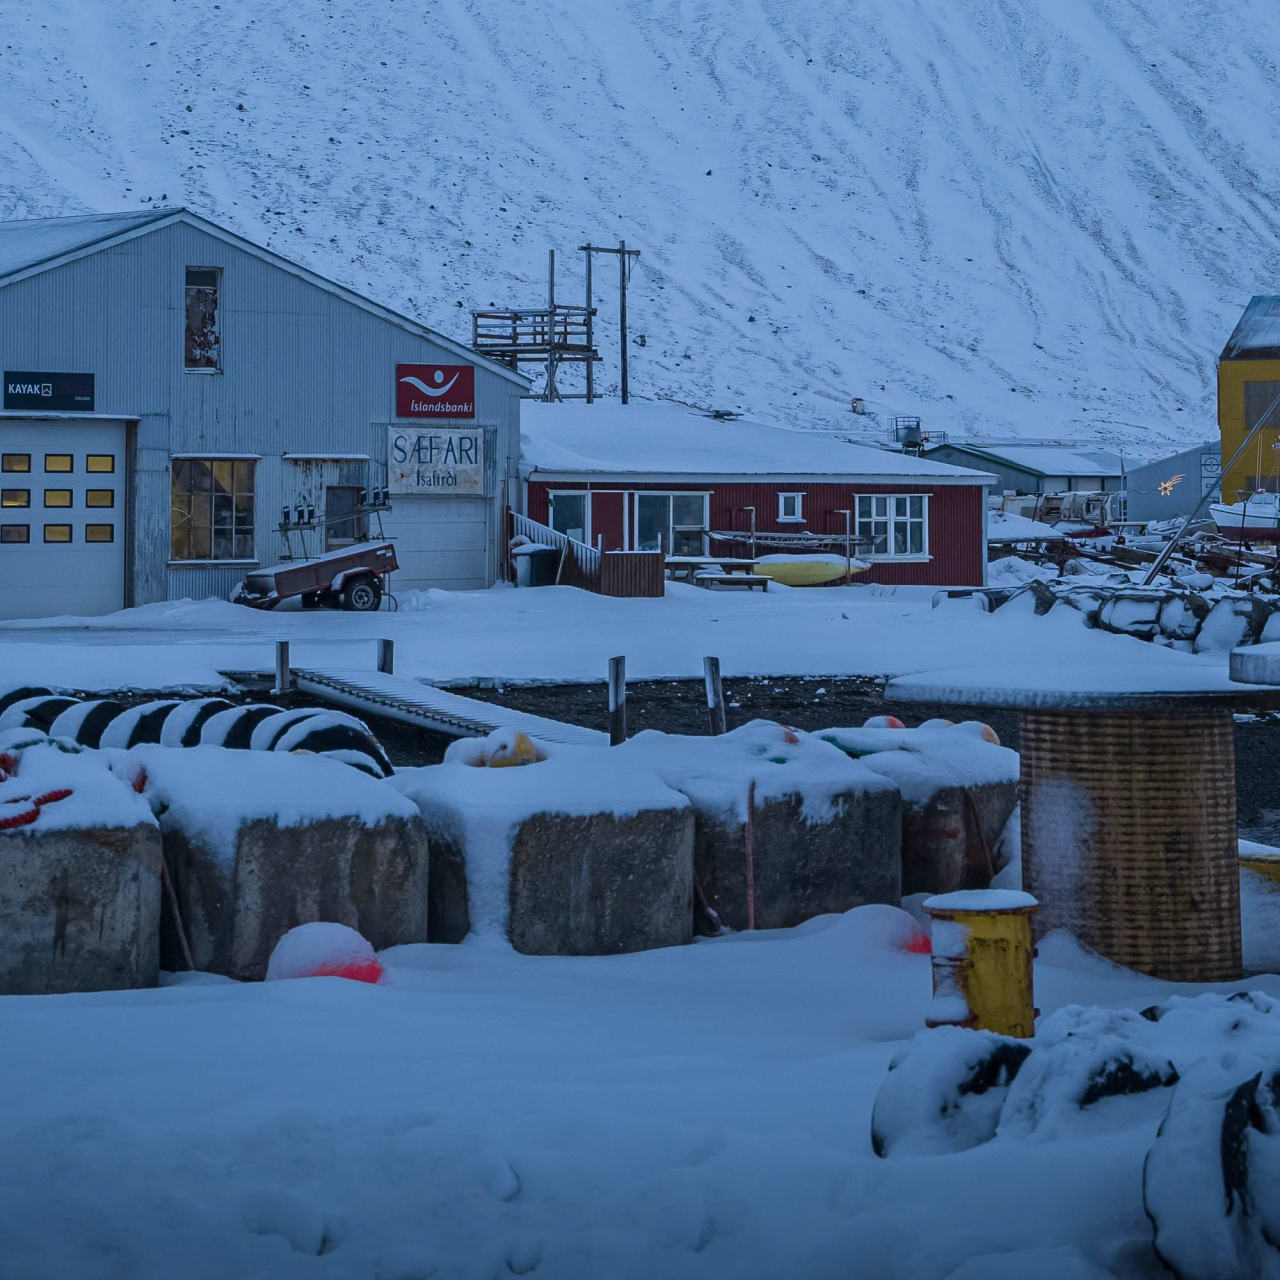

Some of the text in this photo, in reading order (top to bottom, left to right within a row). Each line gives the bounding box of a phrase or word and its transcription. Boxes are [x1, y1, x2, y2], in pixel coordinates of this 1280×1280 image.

[8, 383, 40, 394] KAYAK
[411, 399, 473, 412] Íslandsbanki
[393, 435, 478, 464] SÆFARI
